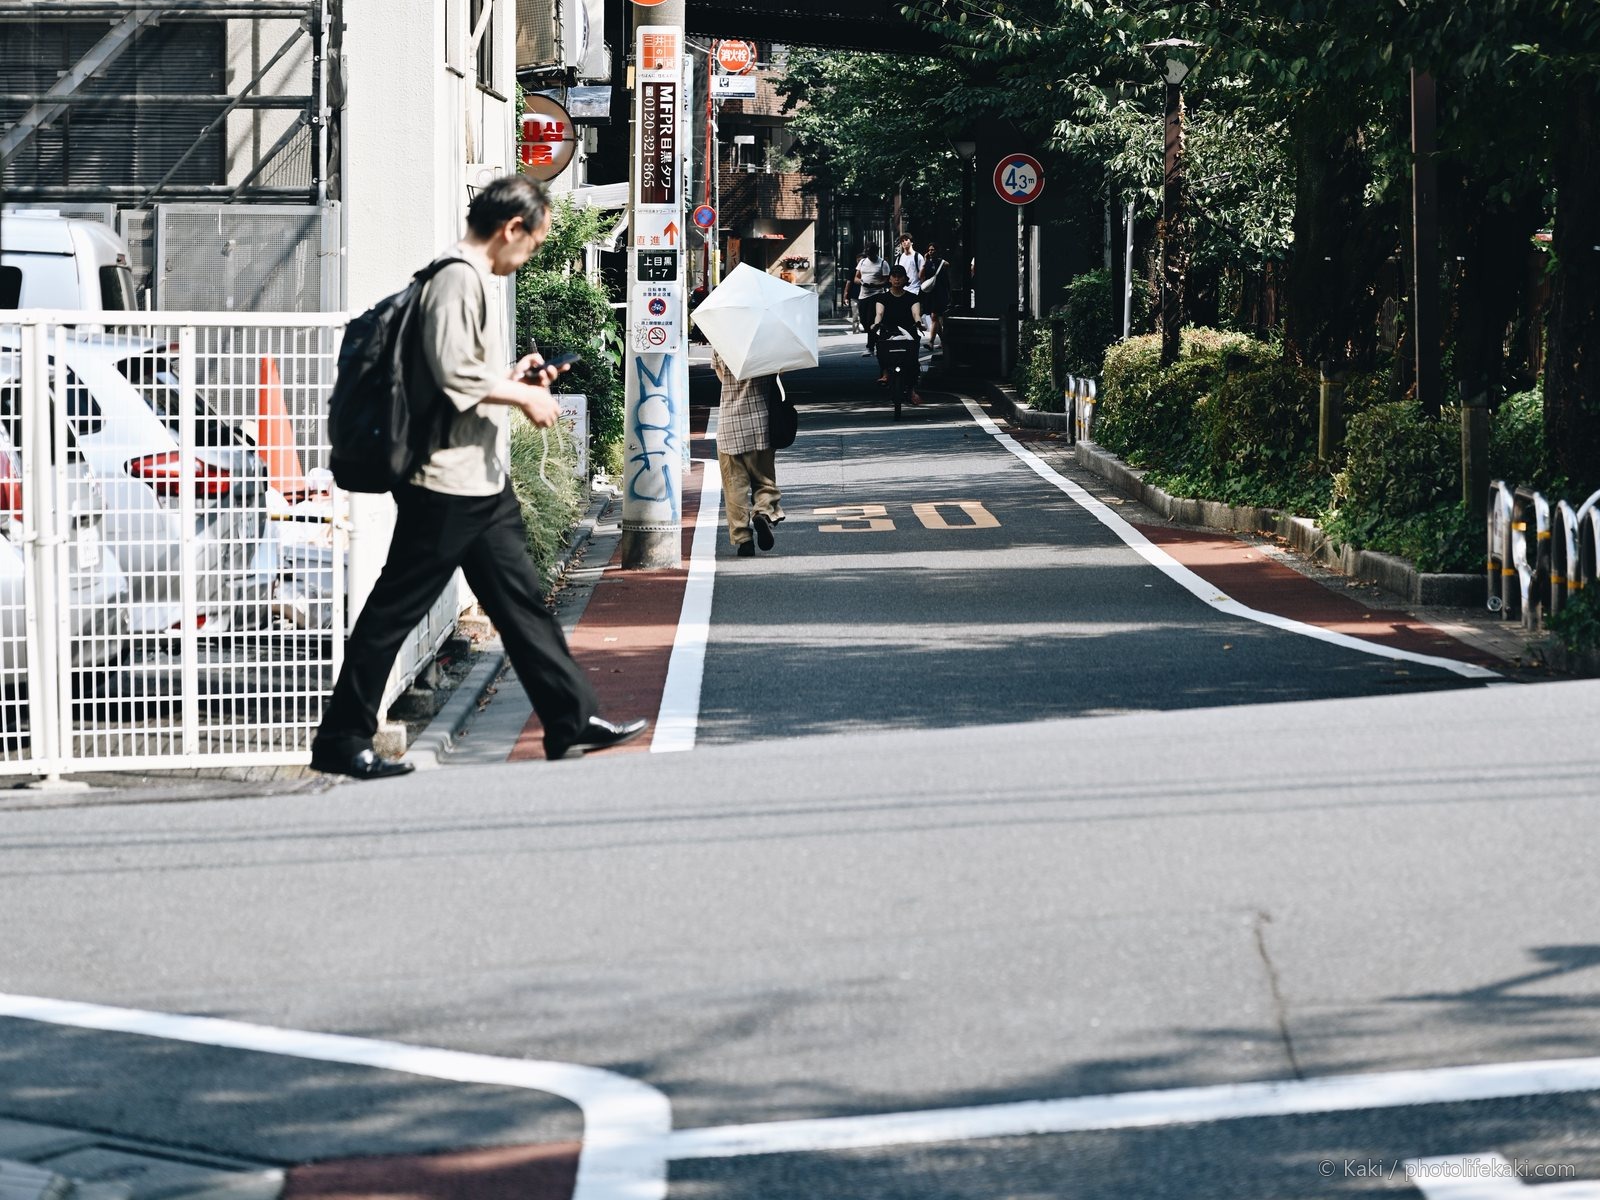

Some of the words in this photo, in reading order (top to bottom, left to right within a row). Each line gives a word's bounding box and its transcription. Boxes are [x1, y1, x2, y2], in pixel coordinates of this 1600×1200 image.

[720, 48, 748, 62] 消火栓
[643, 97, 655, 188] 0120-321-865
[659, 85, 674, 201] MFPR目黒タワー
[636, 235, 660, 246] 直進
[643, 256, 672, 266] 上目黒
[648, 268, 668, 278] 1-7
[813, 499, 1002, 533] 30
